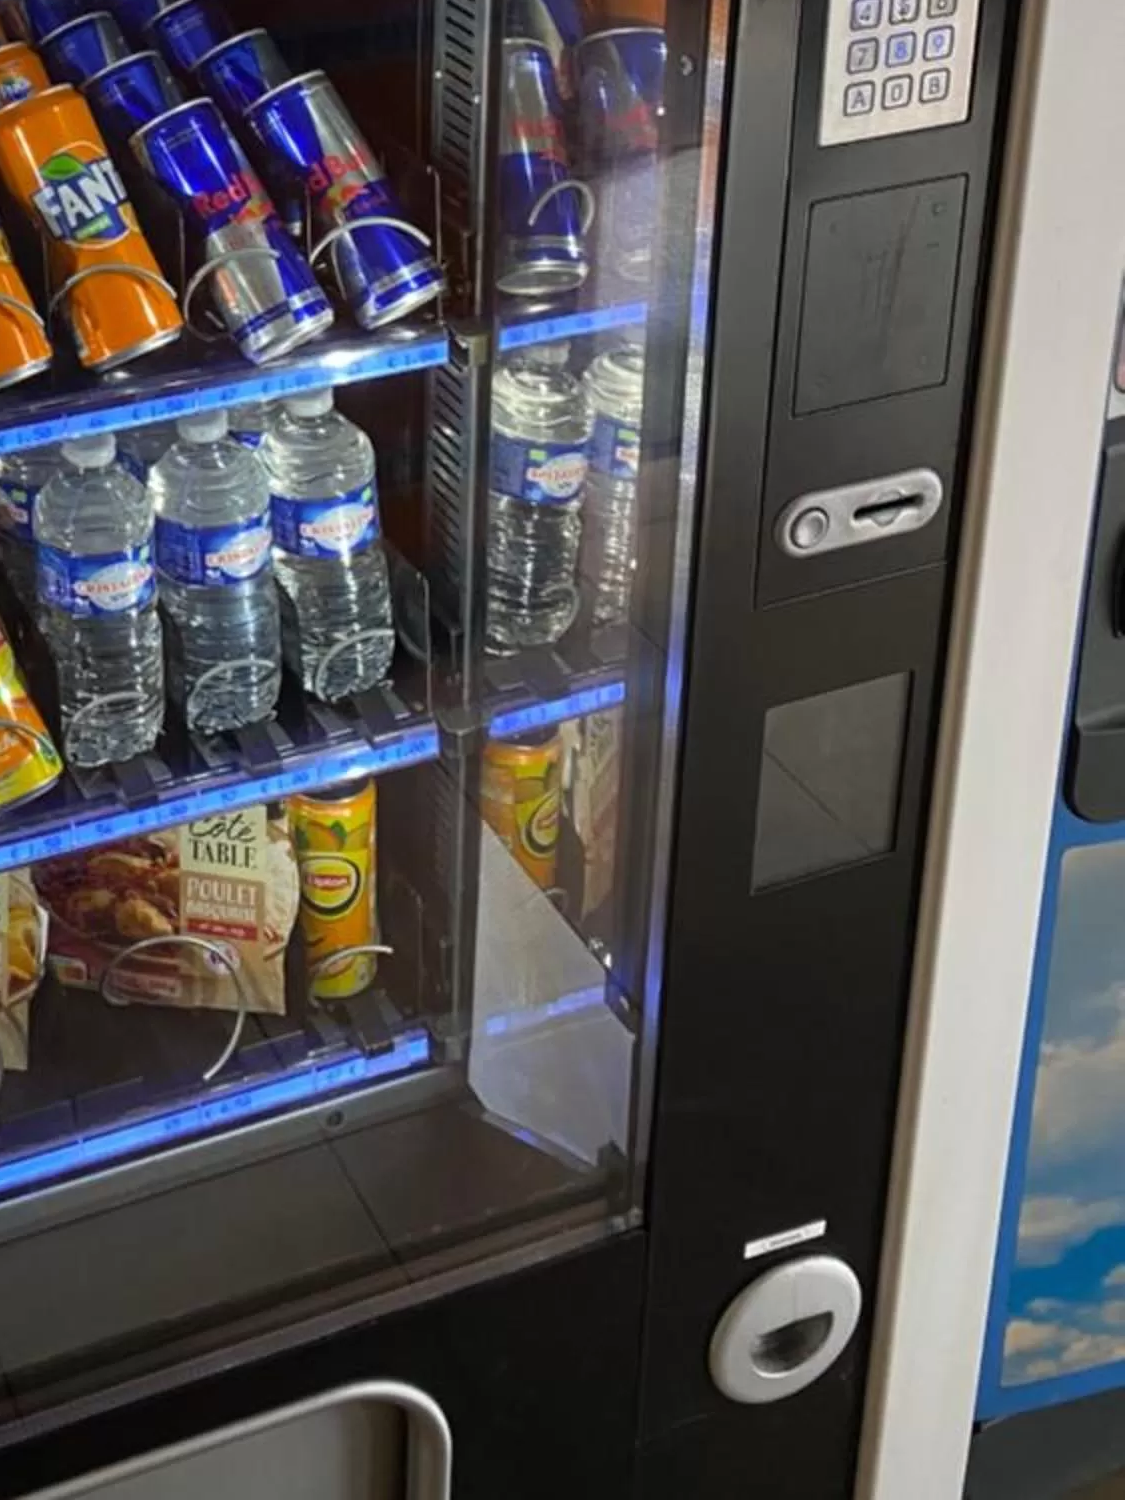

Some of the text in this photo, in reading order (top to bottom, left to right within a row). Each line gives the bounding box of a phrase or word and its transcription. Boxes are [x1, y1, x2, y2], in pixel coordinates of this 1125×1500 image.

[33, 156, 127, 240] FANT
[187, 837, 258, 870] TABLE
[186, 877, 258, 907] POULET
